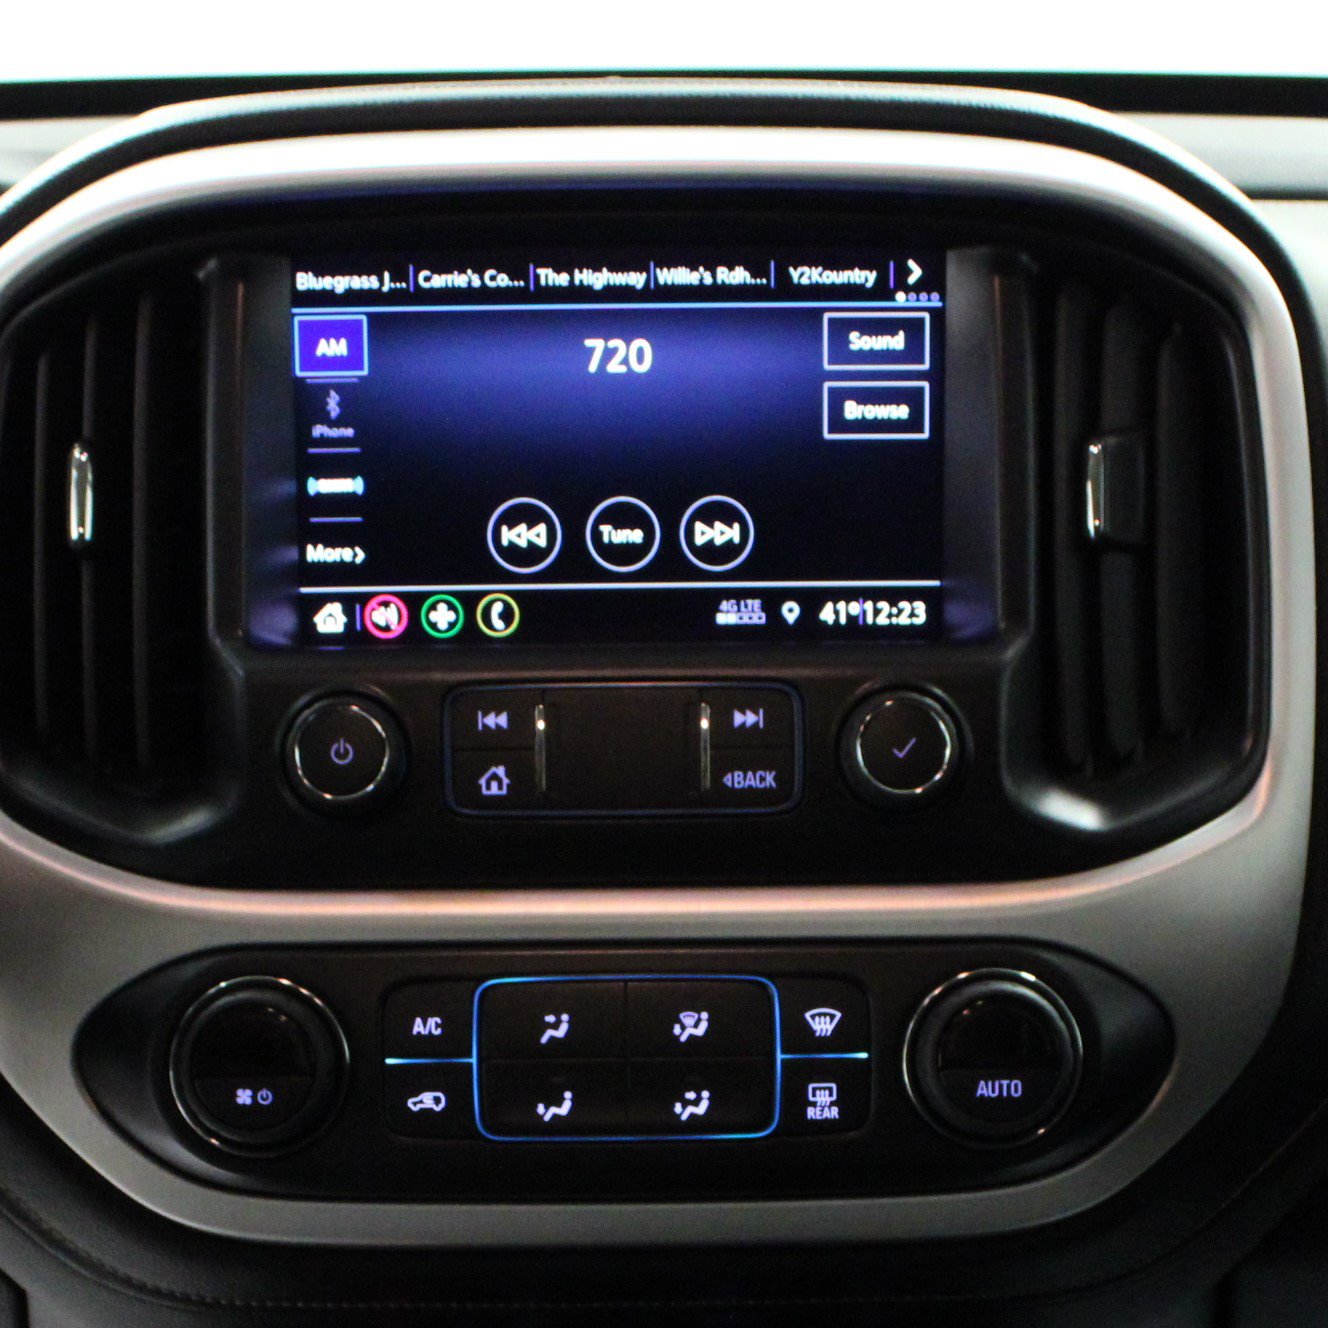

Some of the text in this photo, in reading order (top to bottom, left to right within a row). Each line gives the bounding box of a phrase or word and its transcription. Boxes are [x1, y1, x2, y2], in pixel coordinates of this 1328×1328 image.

[295, 270, 407, 294] Bluegrass J...
[418, 268, 525, 288] Carrie's Co...
[536, 266, 648, 291] The Highway
[656, 265, 714, 285] Willie's
[788, 265, 877, 288] Y2Kountry
[315, 337, 349, 358] AM
[848, 329, 906, 351] Sound
[584, 338, 653, 374] 720
[844, 399, 911, 421] Browse
[599, 523, 644, 545] Tune
[305, 543, 355, 564] More
[719, 599, 762, 613] 4G LTE
[862, 600, 927, 626] 12:23
[733, 770, 777, 789] BACK
[412, 1016, 443, 1036] A/C
[976, 1079, 1023, 1098] AUTO
[806, 1106, 840, 1120] REAR
